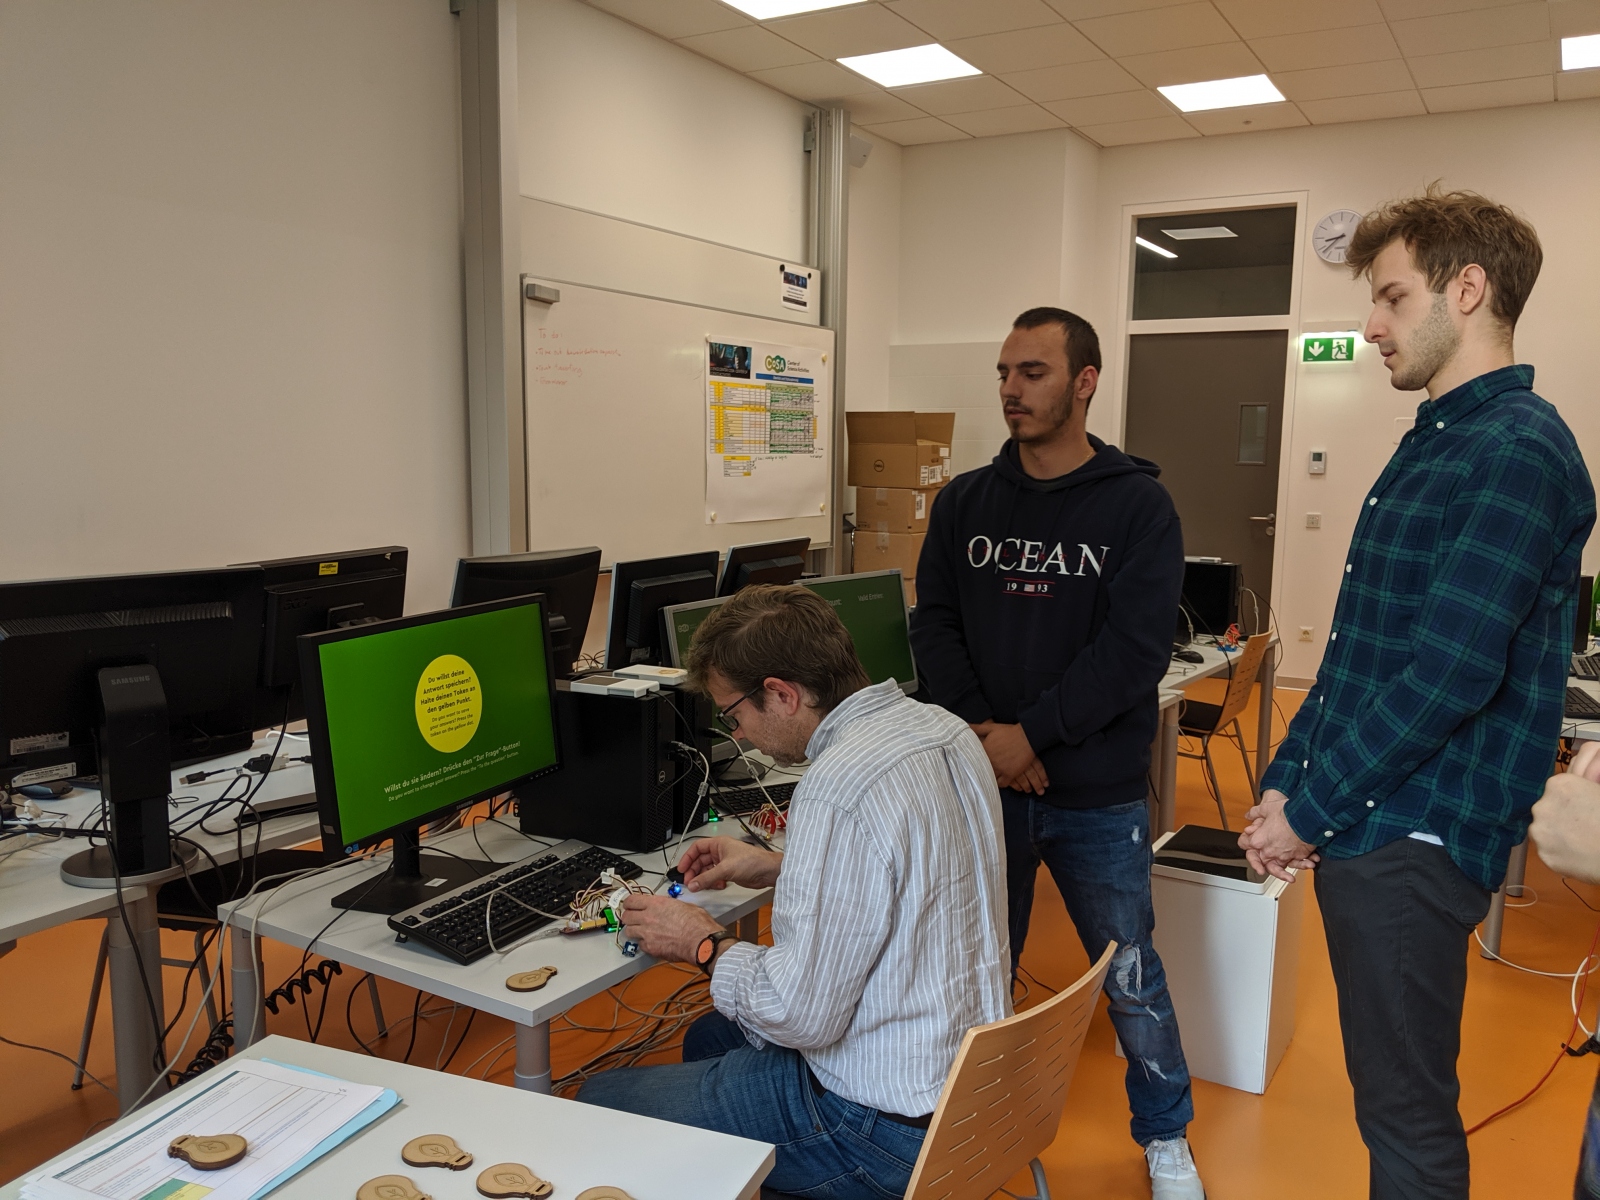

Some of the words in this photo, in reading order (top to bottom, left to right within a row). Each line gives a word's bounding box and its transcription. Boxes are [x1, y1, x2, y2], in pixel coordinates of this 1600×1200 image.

[967, 535, 1110, 578] OCEAN
[1006, 582, 1018, 591] 19
[1037, 584, 1048, 592] 93
[111, 675, 150, 685] SAMSUNG
[436, 673, 450, 681] willst
[451, 669, 464, 677] deine
[423, 685, 444, 695] Antwort
[445, 677, 471, 689] speichern?
[436, 692, 452, 701] deinen
[438, 700, 455, 711] gelben
[456, 696, 472, 705] Punkt.
[454, 723, 466, 732] yellow
[384, 783, 401, 794] Willst
[411, 776, 419, 784] sie
[420, 768, 442, 781] ändern?
[443, 762, 461, 773] Drücke
[420, 782, 434, 790] change
